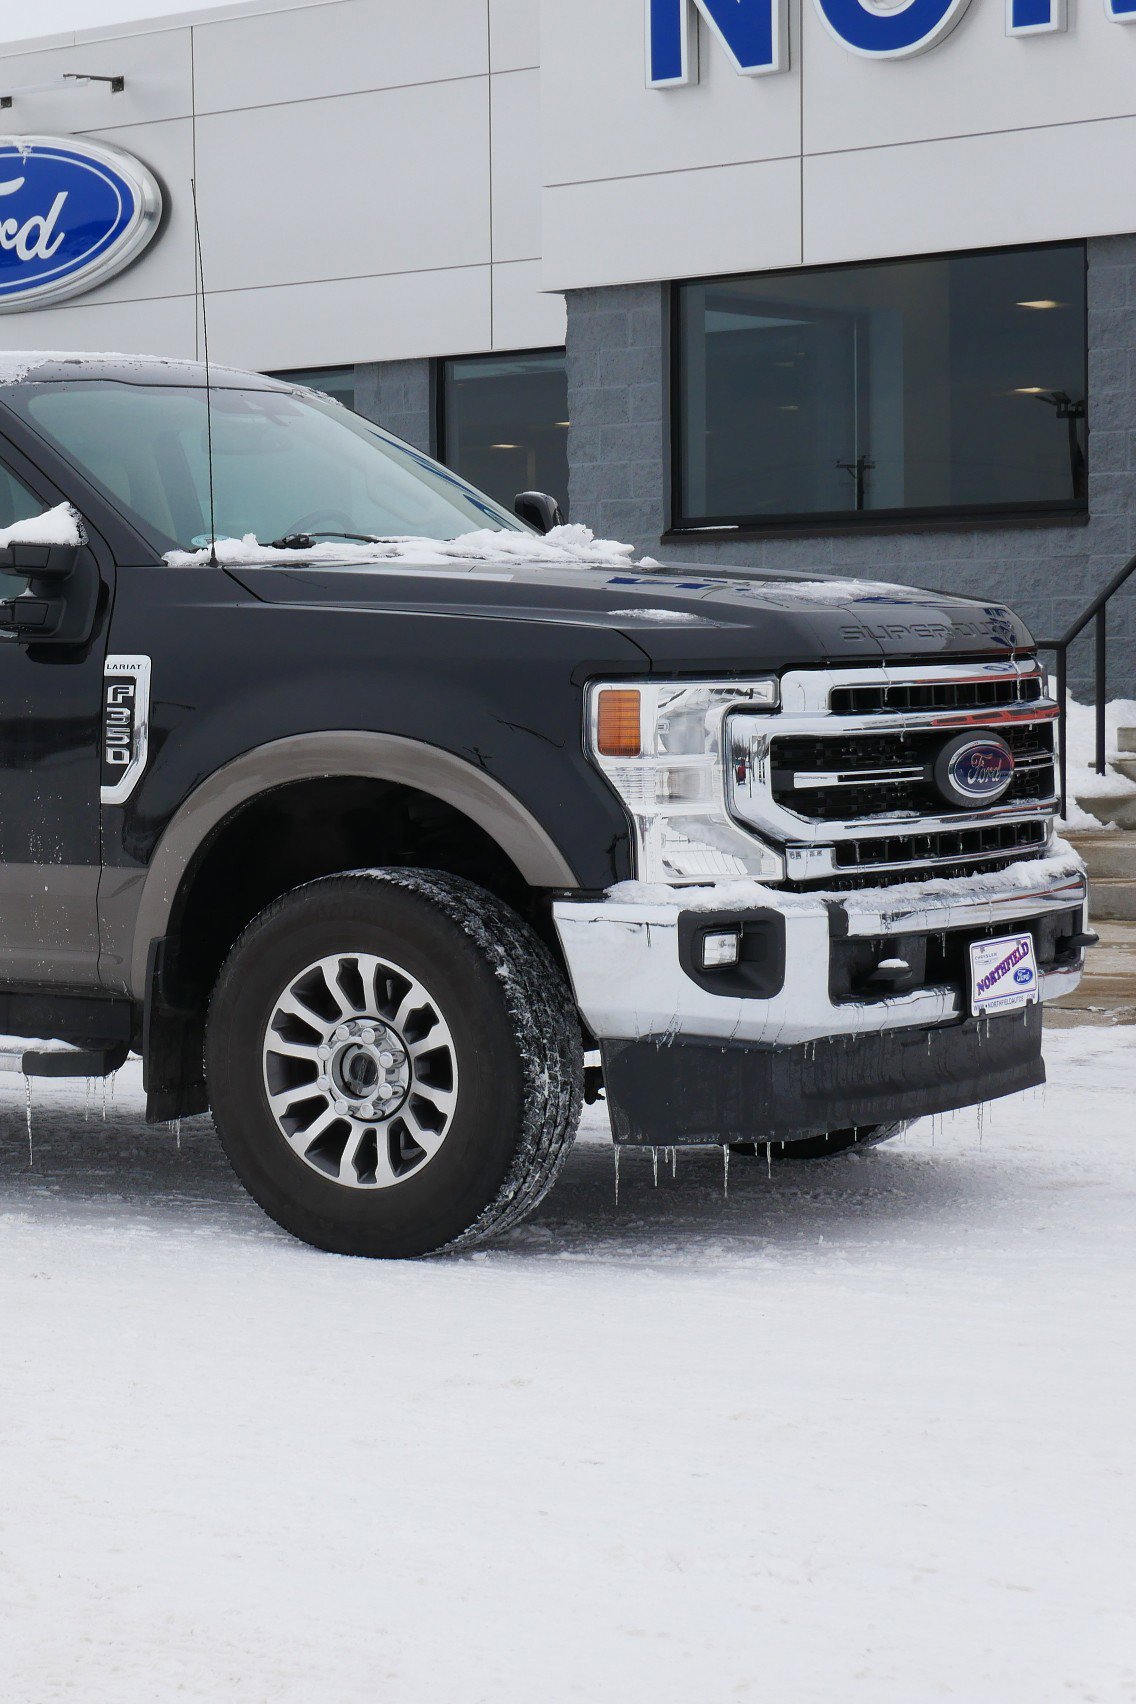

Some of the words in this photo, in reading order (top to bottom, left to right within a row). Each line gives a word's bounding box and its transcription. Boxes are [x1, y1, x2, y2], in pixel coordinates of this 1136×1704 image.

[840, 623, 949, 641] SUPER
[106, 684, 135, 765] F350
[967, 752, 1002, 784] Ford
[976, 941, 1030, 996] NORTHFIELD
